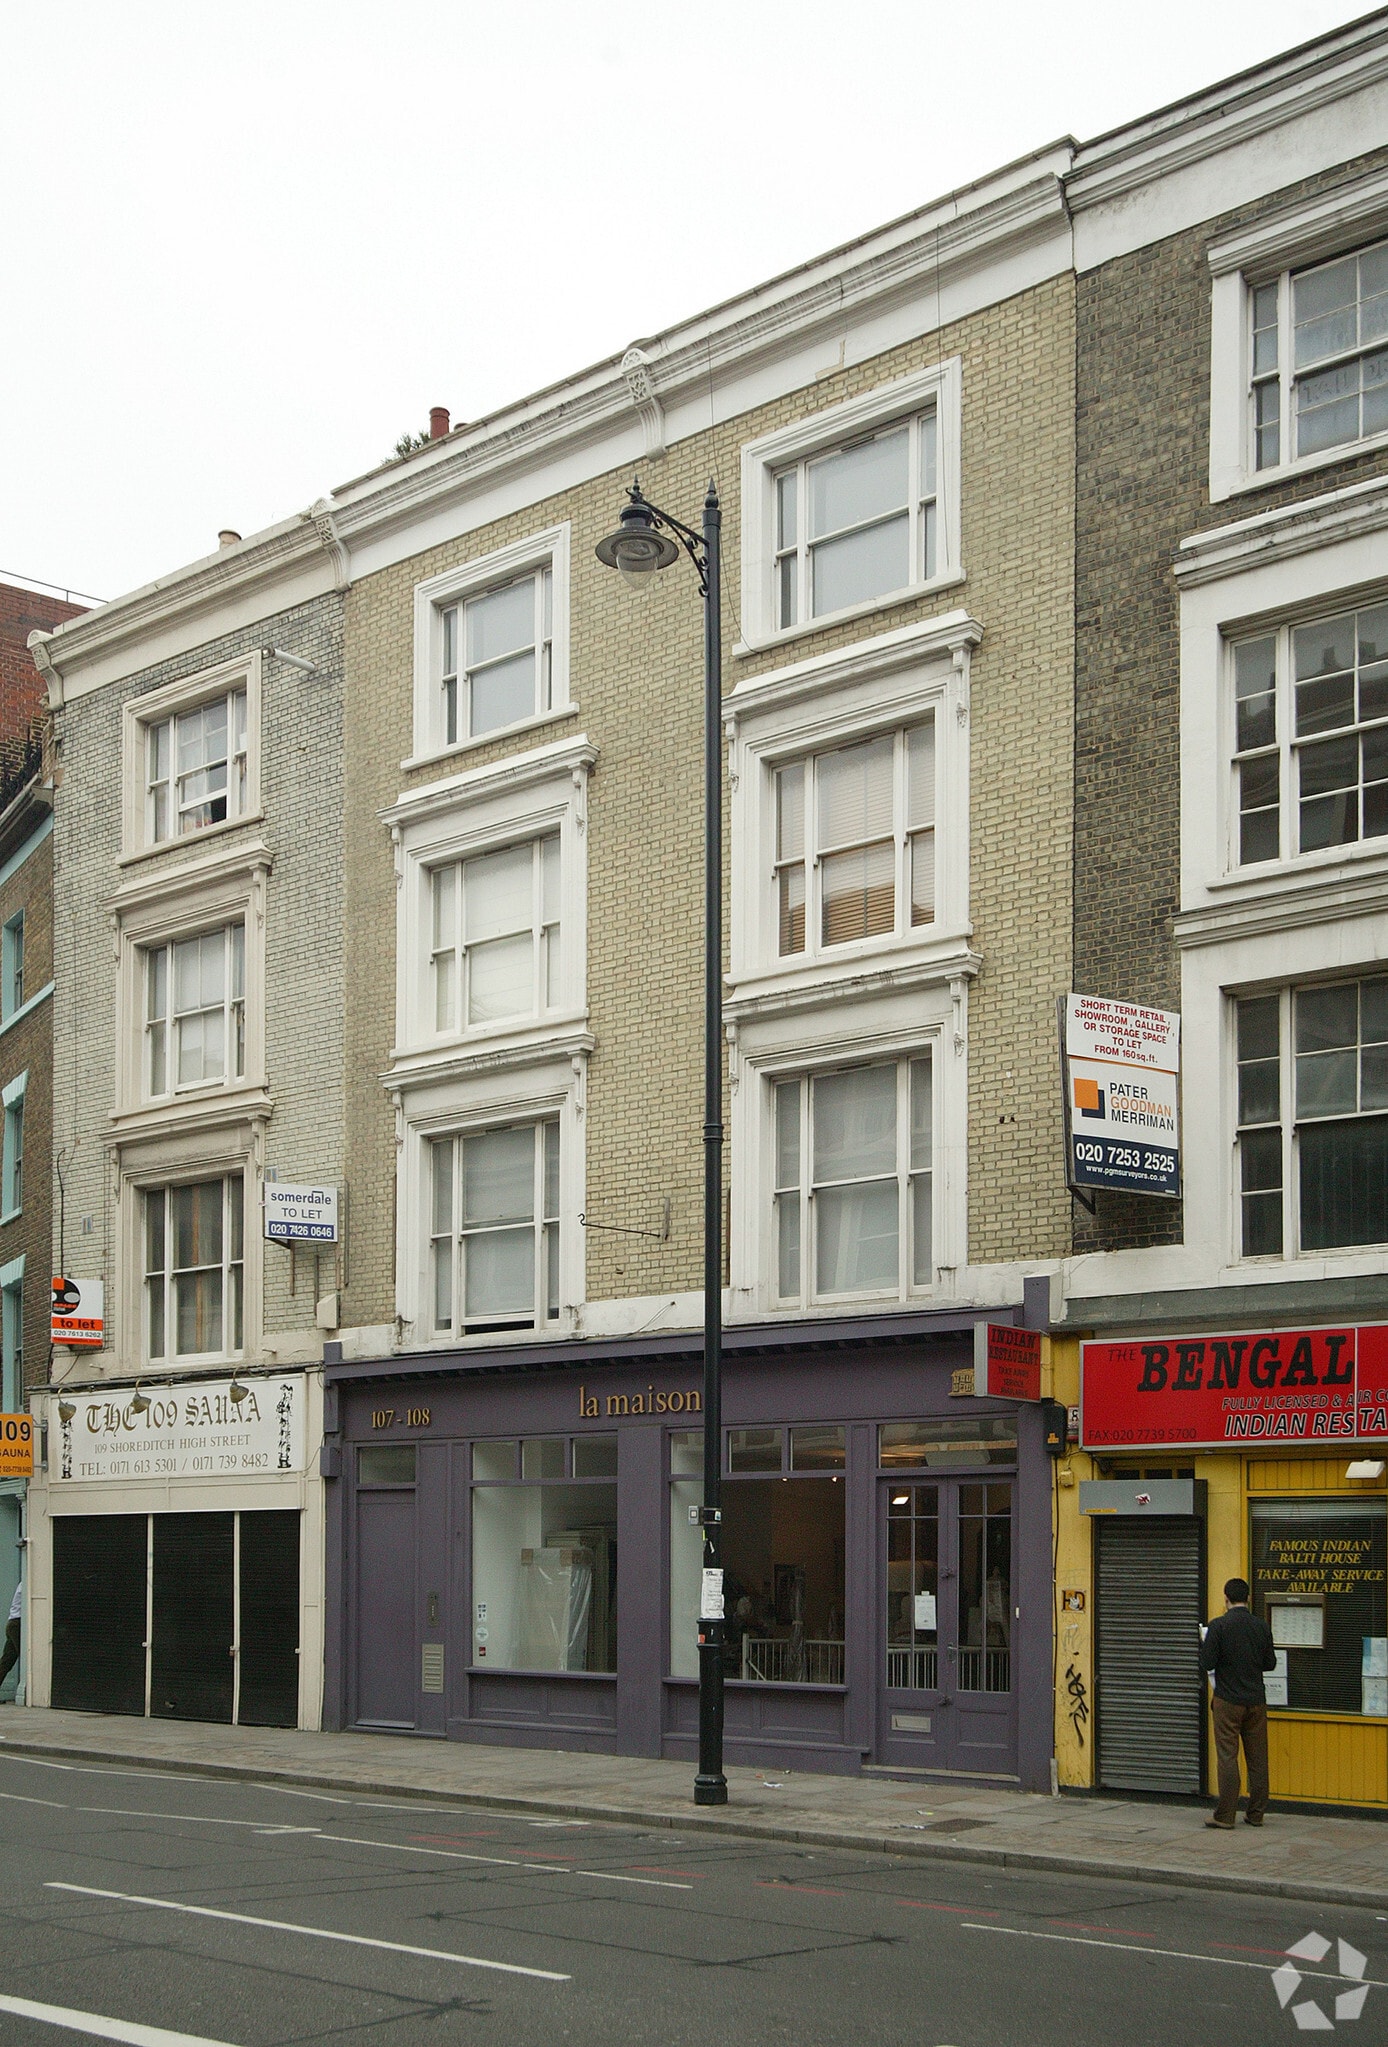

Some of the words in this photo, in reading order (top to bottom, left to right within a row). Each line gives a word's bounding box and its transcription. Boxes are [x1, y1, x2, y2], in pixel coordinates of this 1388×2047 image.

[1080, 999, 1111, 1012] SHORT
[1114, 1004, 1138, 1016] TERM
[1084, 1021, 1096, 1031] OR
[1099, 1024, 1140, 1038] STORAGE
[1142, 1031, 1167, 1044] SPACE
[1094, 1044, 1119, 1056] FROM
[1112, 1036, 1124, 1046] TO
[1127, 1040, 1142, 1050] LET
[1110, 1082, 1148, 1100] PATER
[1110, 1096, 1171, 1117] GOODMAN
[1111, 1109, 1174, 1131] MERRIMAN
[1076, 1142, 1103, 1162] 020
[1107, 1146, 1140, 1168] 7253
[1144, 1152, 1175, 1173] 2525
[1086, 1164, 1168, 1182] www.pgmsurveyors.co.uk
[270, 1190, 332, 1205] somerdale
[281, 1208, 297, 1218] TO
[301, 1209, 322, 1219] LET
[270, 1223, 287, 1234] 020
[289, 1225, 308, 1236] 7426
[310, 1226, 332, 1237] 0646
[60, 1318, 74, 1328] to
[78, 1319, 95, 1329] let
[991, 1328, 1037, 1349] INDIAN
[989, 1345, 1039, 1366] RESTAURANT
[1107, 1347, 1136, 1362] THE
[1137, 1336, 1354, 1392] BENGAL
[578, 1385, 599, 1418] la
[605, 1384, 702, 1416] maison
[1221, 1396, 1261, 1411] FULLY
[1264, 1394, 1329, 1410] LICENSED
[1332, 1394, 1342, 1407] &
[85, 1401, 137, 1437] THE
[146, 1400, 178, 1429] 109
[184, 1391, 262, 1427] SAUNA
[370, 1410, 394, 1429] 107
[406, 1407, 431, 1427] 108
[1136, 1429, 1165, 1440] 7739
[1168, 1428, 1197, 1440] 5700
[1224, 1413, 1307, 1437] INDIAN
[94, 1443, 107, 1454] 109
[109, 1439, 175, 1453] SHOREDITCH
[179, 1437, 207, 1449] HIGH
[210, 1434, 251, 1447] STREET
[79, 1462, 106, 1476] TEL:
[110, 1460, 129, 1475] 0171
[133, 1459, 150, 1473] 613
[154, 1458, 177, 1472] 5301
[192, 1456, 213, 1470] 0171
[219, 1454, 237, 1469] 739
[241, 1453, 268, 1468] 8482
[1269, 1540, 1319, 1551] FAMOUS
[1322, 1540, 1371, 1551] INDIAN
[1280, 1553, 1316, 1564] BALTI
[1319, 1553, 1362, 1564] HOUSE
[1257, 1568, 1328, 1580] TAKE-AWAY
[1331, 1569, 1385, 1581] SERVICE
[1286, 1582, 1354, 1593] AVAILABLE
